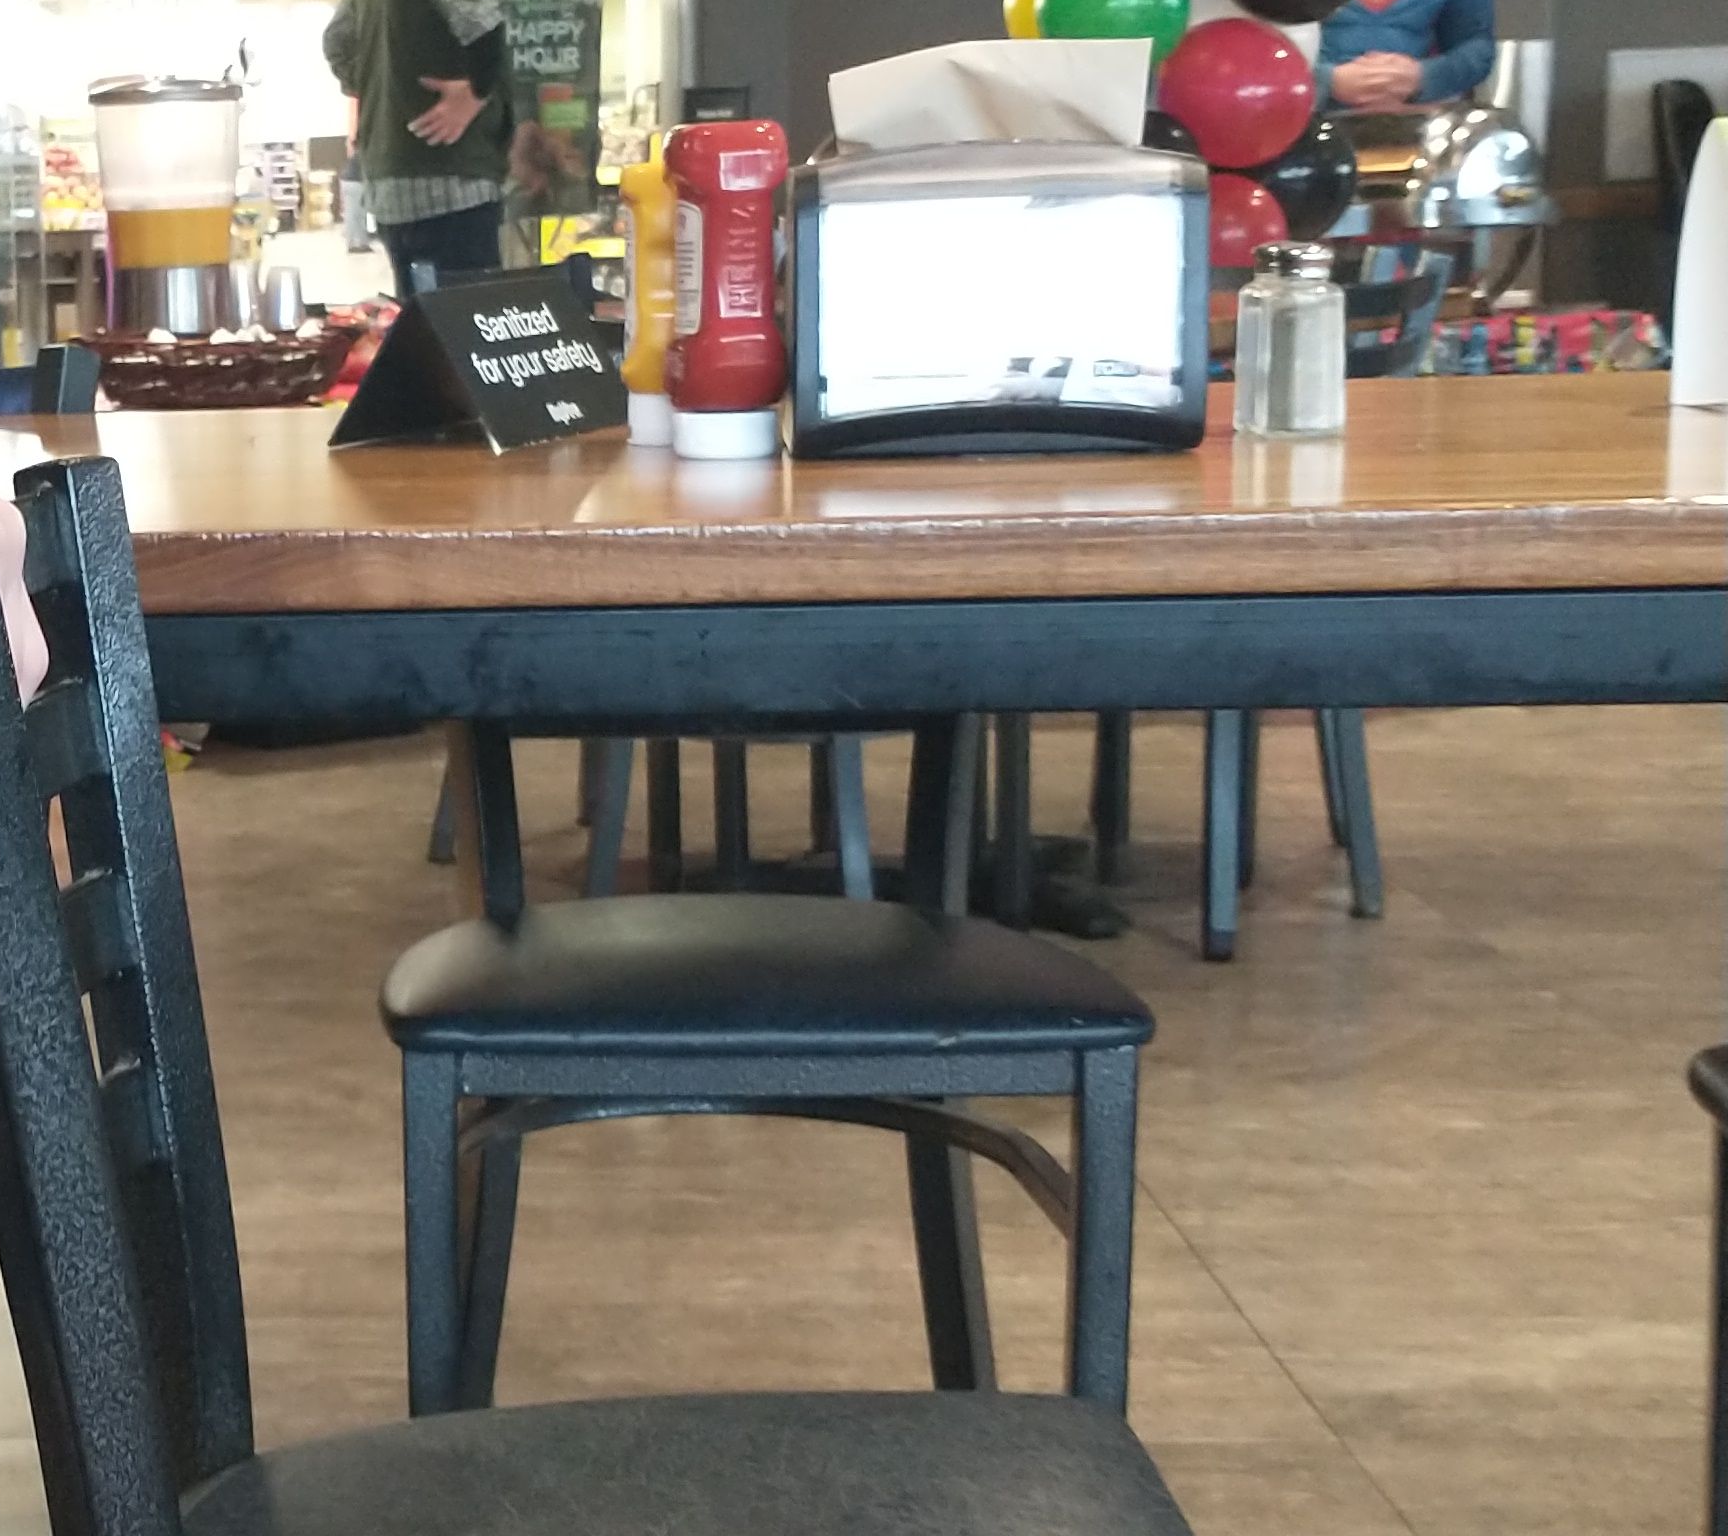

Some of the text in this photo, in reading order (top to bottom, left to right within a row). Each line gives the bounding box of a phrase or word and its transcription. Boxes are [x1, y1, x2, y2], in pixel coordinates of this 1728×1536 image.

[505, 19, 585, 45] HAPPY
[513, 46, 581, 73] HOUR
[473, 302, 560, 342] Sanitized
[471, 339, 604, 387] for your safety
